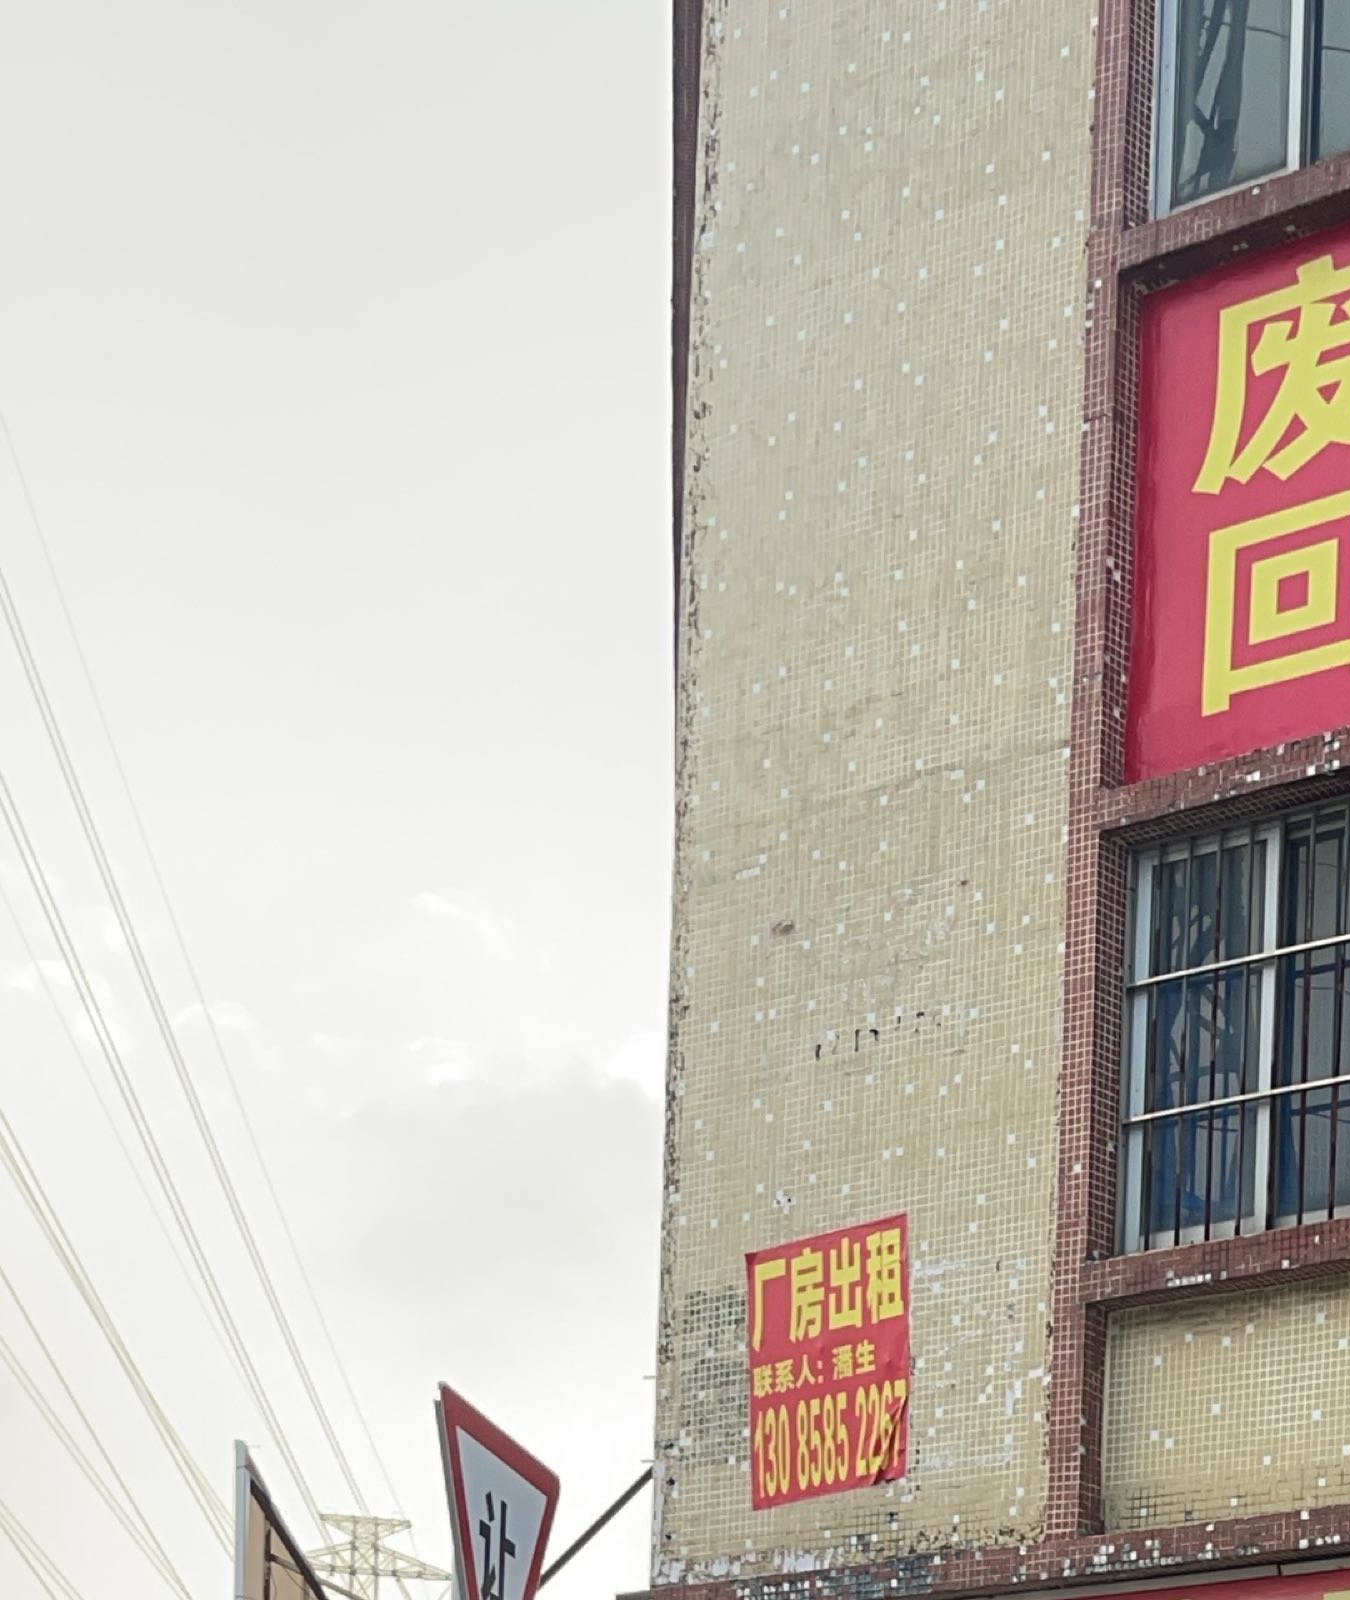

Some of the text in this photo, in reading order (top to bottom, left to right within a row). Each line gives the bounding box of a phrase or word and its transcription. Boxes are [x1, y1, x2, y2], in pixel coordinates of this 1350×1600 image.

[752, 1228, 904, 1351] 厂房出租
[754, 1404, 791, 1499] 130
[796, 1391, 849, 1491] 8585
